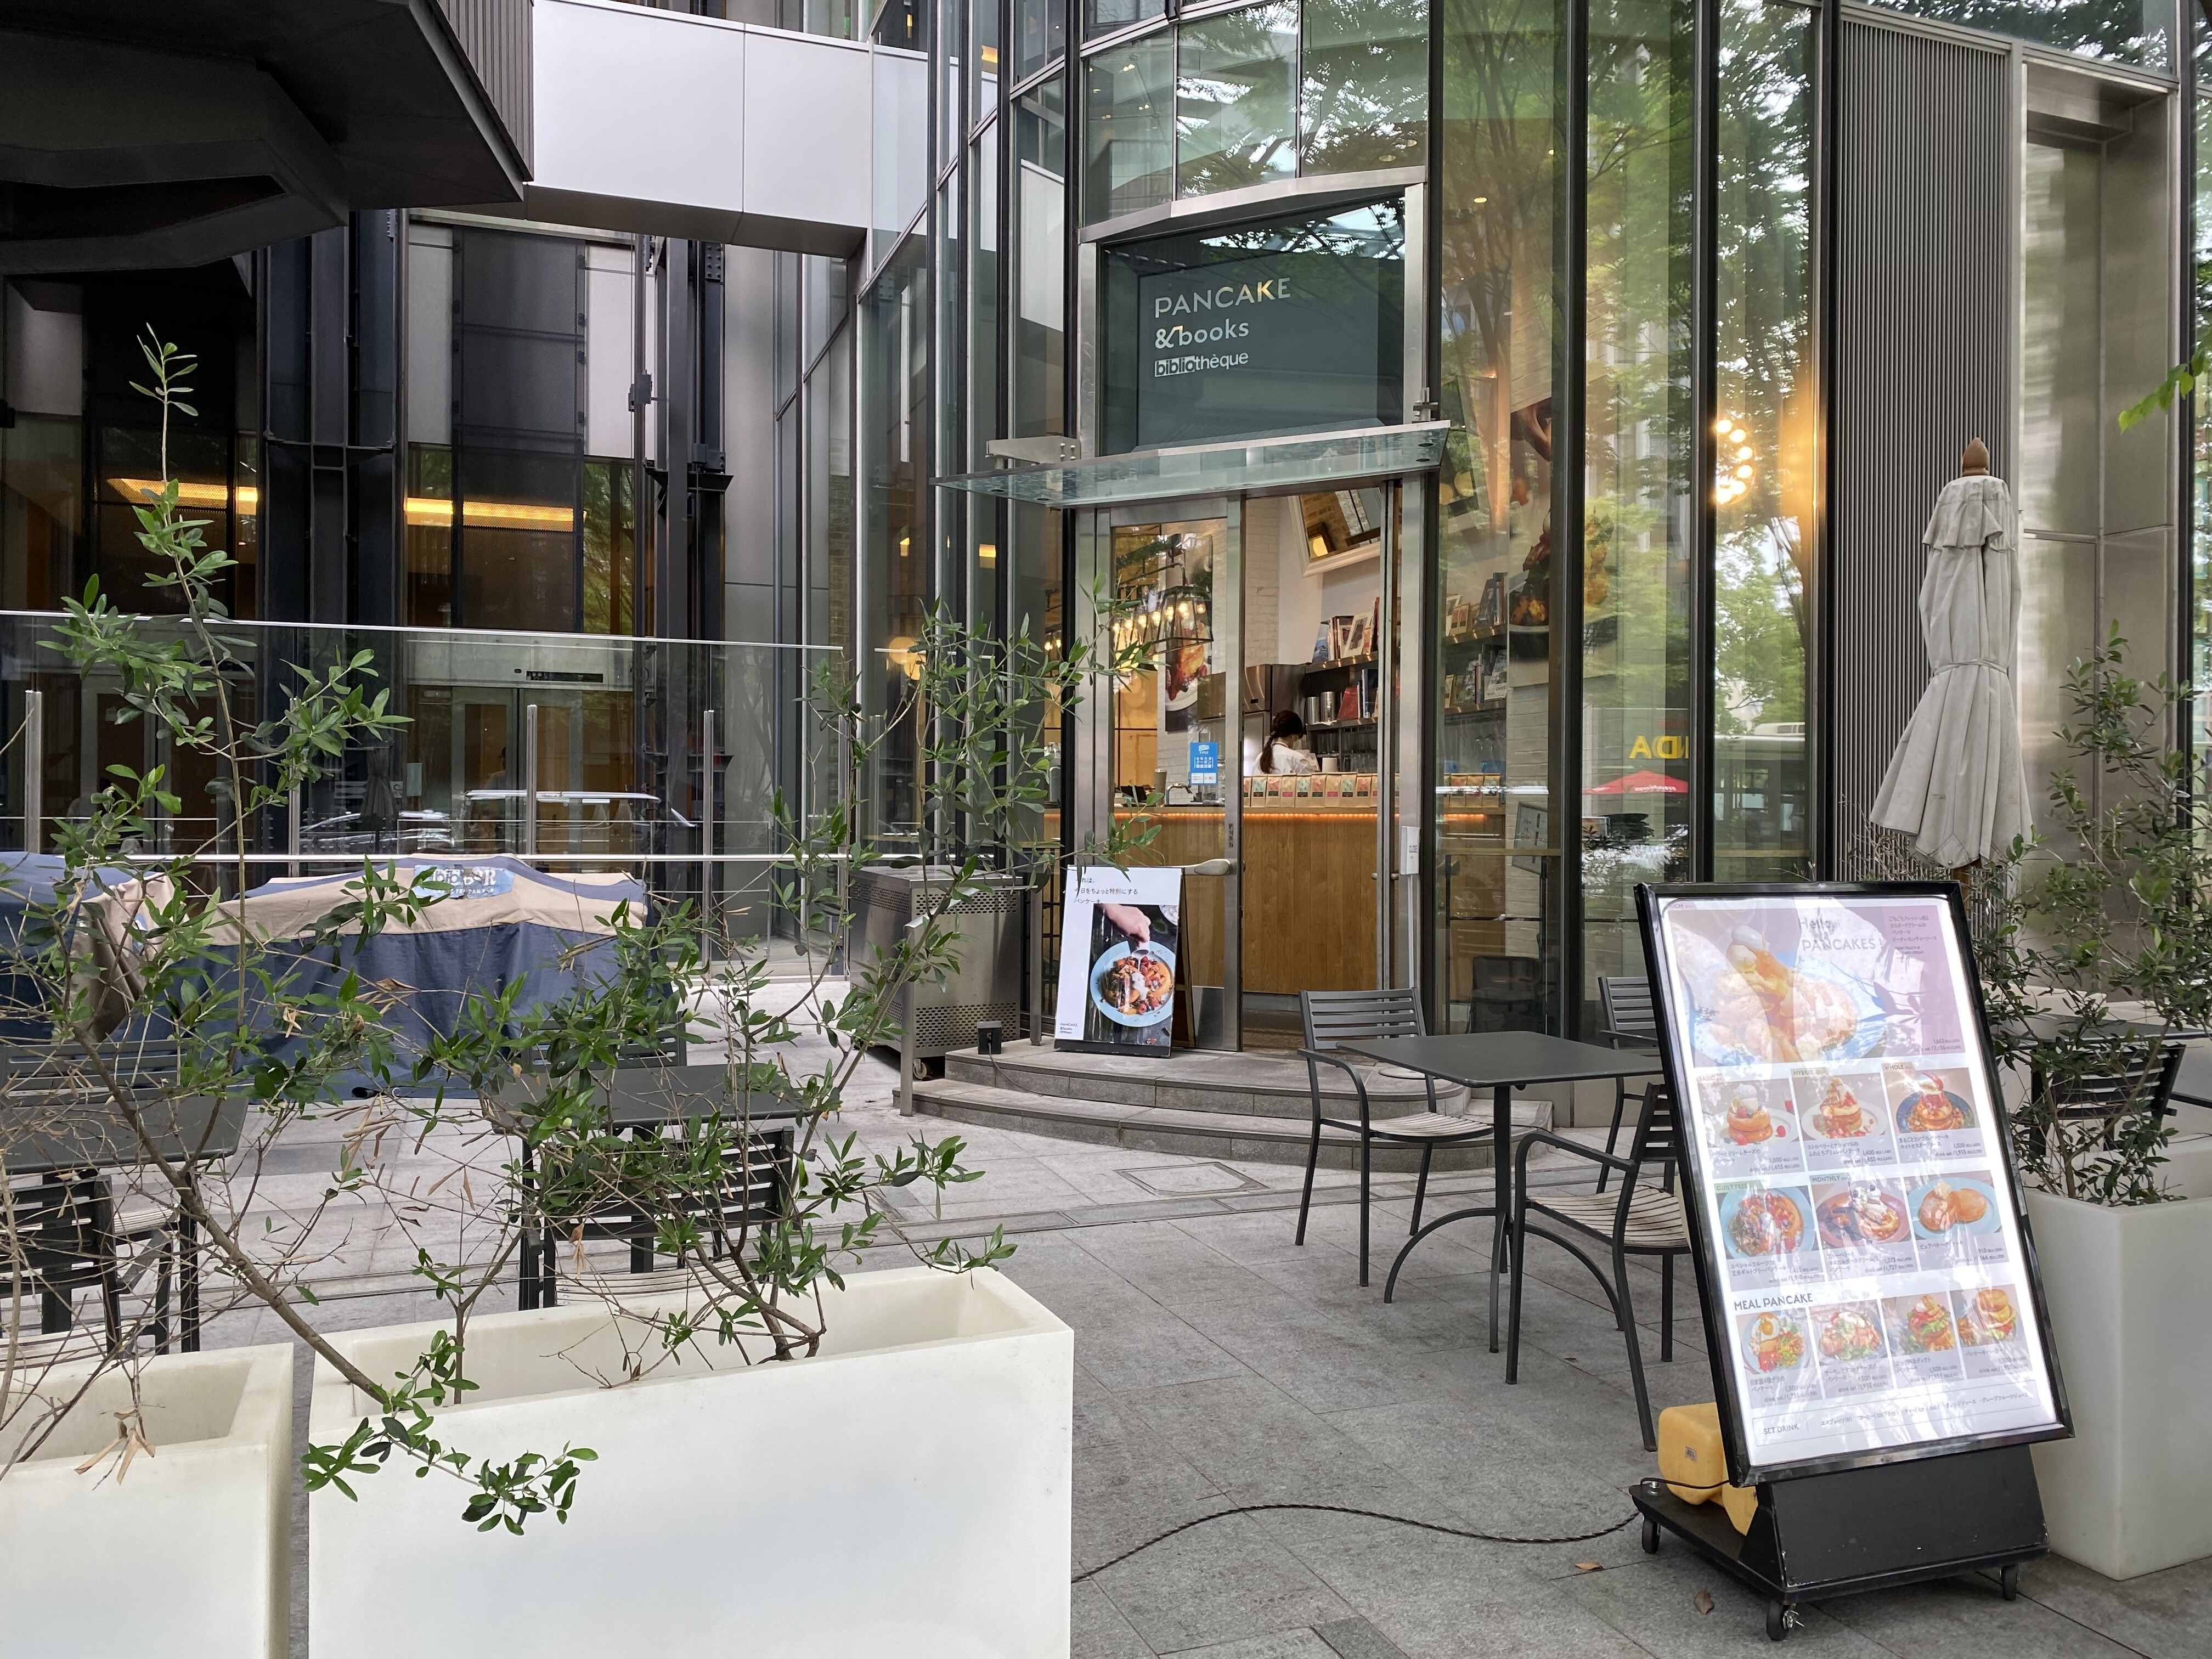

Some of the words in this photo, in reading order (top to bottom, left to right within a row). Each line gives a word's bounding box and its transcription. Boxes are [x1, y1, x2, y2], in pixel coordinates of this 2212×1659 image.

[1155, 277, 1291, 318] PANCAKE
[1155, 318, 1249, 349] &books
[1155, 353, 1249, 377] bibliothèque
[1734, 1299, 1762, 1311] MEAL
[1763, 1293, 1813, 1307] PANCAKE
[1777, 1424, 1799, 1433] DRINK
